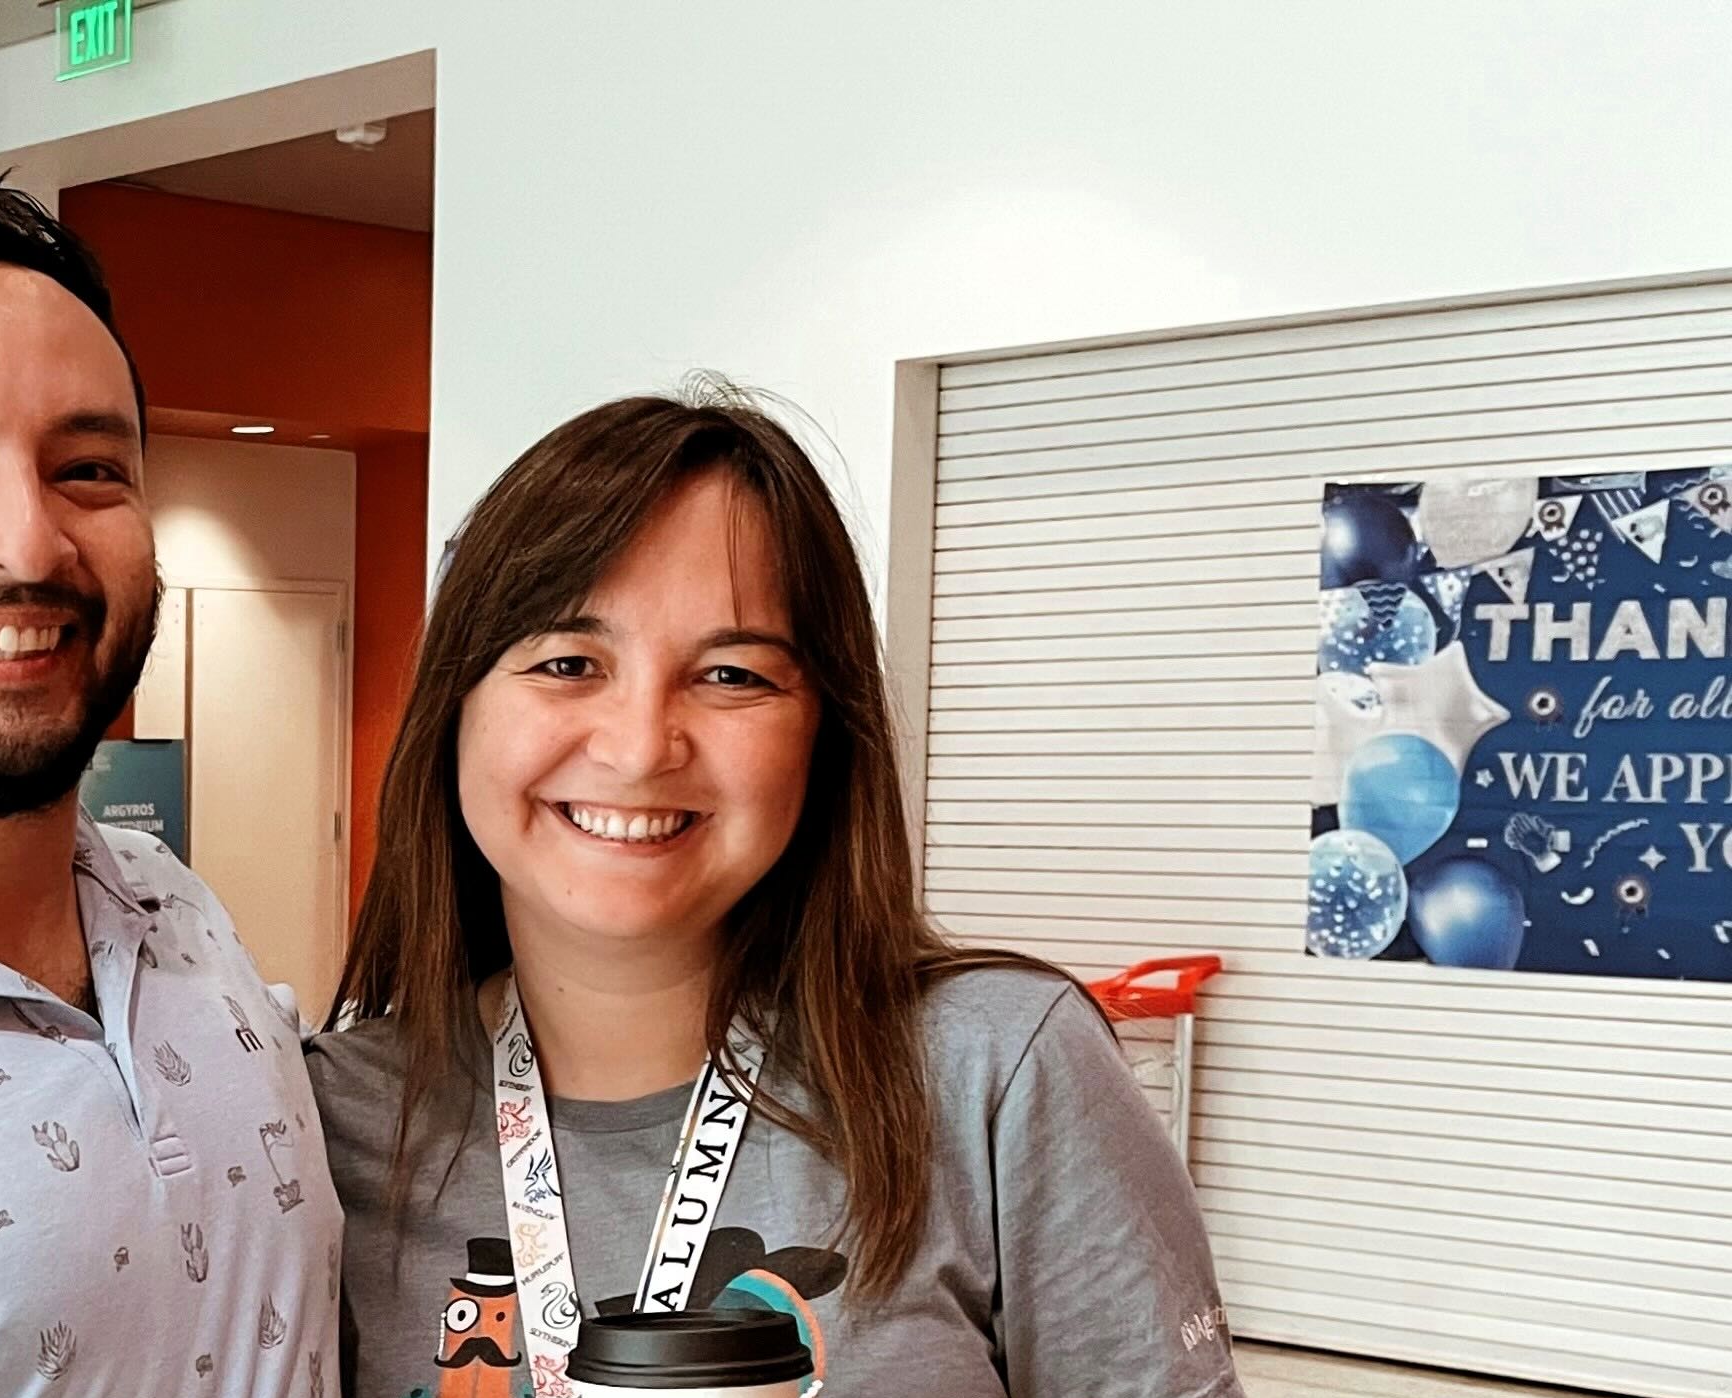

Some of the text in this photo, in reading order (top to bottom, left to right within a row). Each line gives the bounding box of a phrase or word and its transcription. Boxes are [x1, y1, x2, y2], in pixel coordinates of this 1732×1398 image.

[70, 1, 118, 64] EXIT
[1475, 597, 1728, 662] THAN
[1573, 675, 1655, 739] for
[1498, 752, 1732, 804] WE APP
[102, 803, 156, 817] ARGYROS
[1679, 821, 1732, 873] Y
